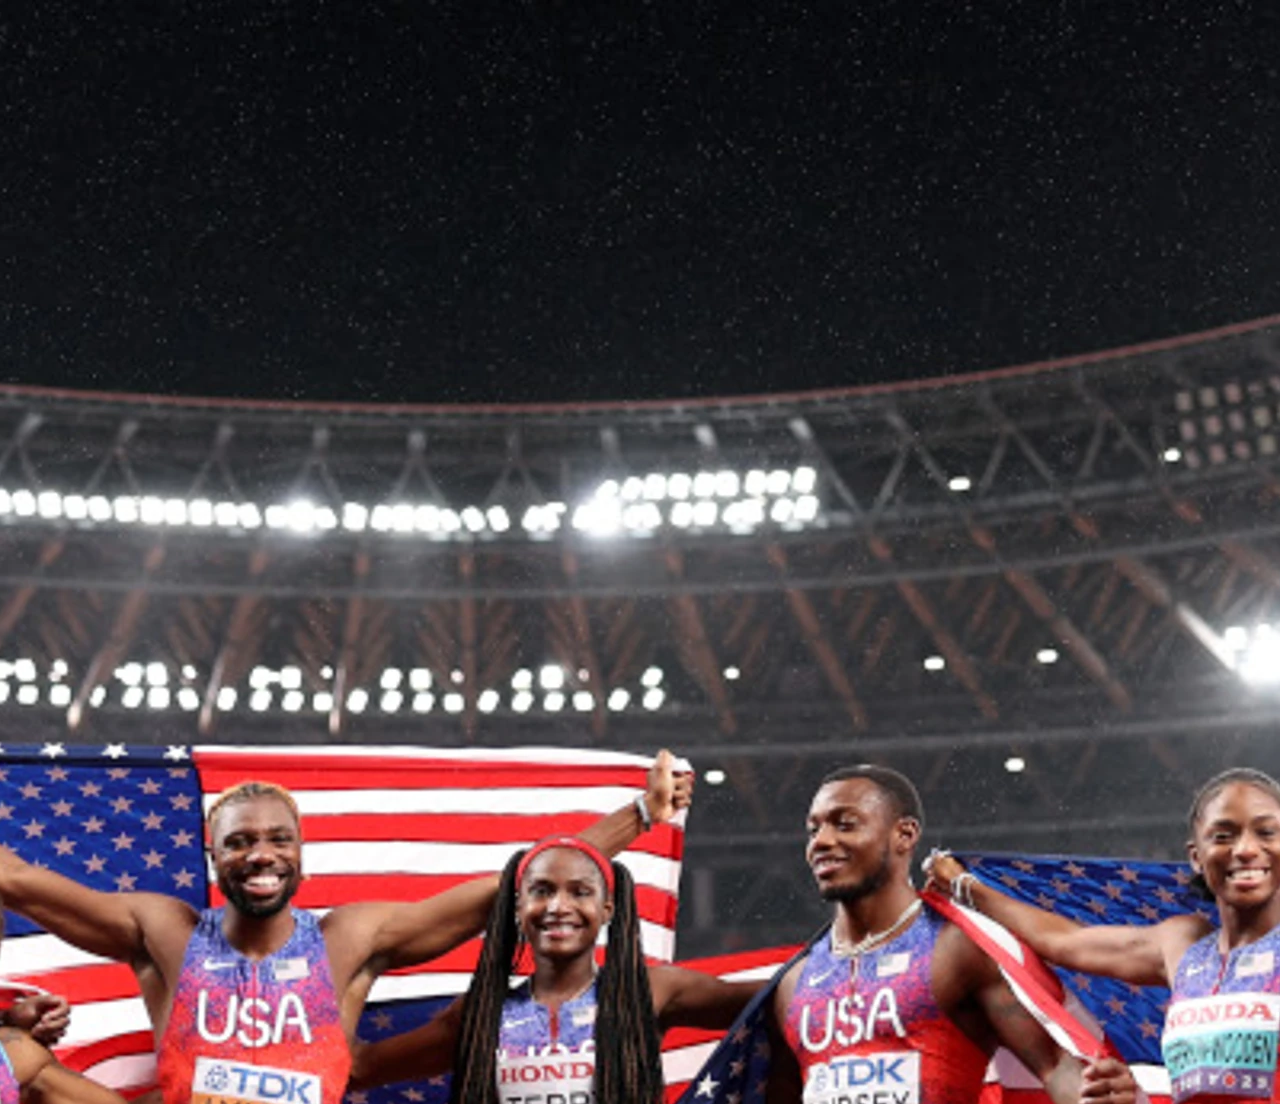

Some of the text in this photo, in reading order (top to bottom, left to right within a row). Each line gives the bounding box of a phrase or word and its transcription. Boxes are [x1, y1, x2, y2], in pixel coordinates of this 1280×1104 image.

[197, 989, 313, 1047] USA
[800, 988, 906, 1053] USA
[231, 1066, 313, 1104] TDK
[501, 1062, 594, 1085] HOND
[829, 1058, 905, 1088] TDK
